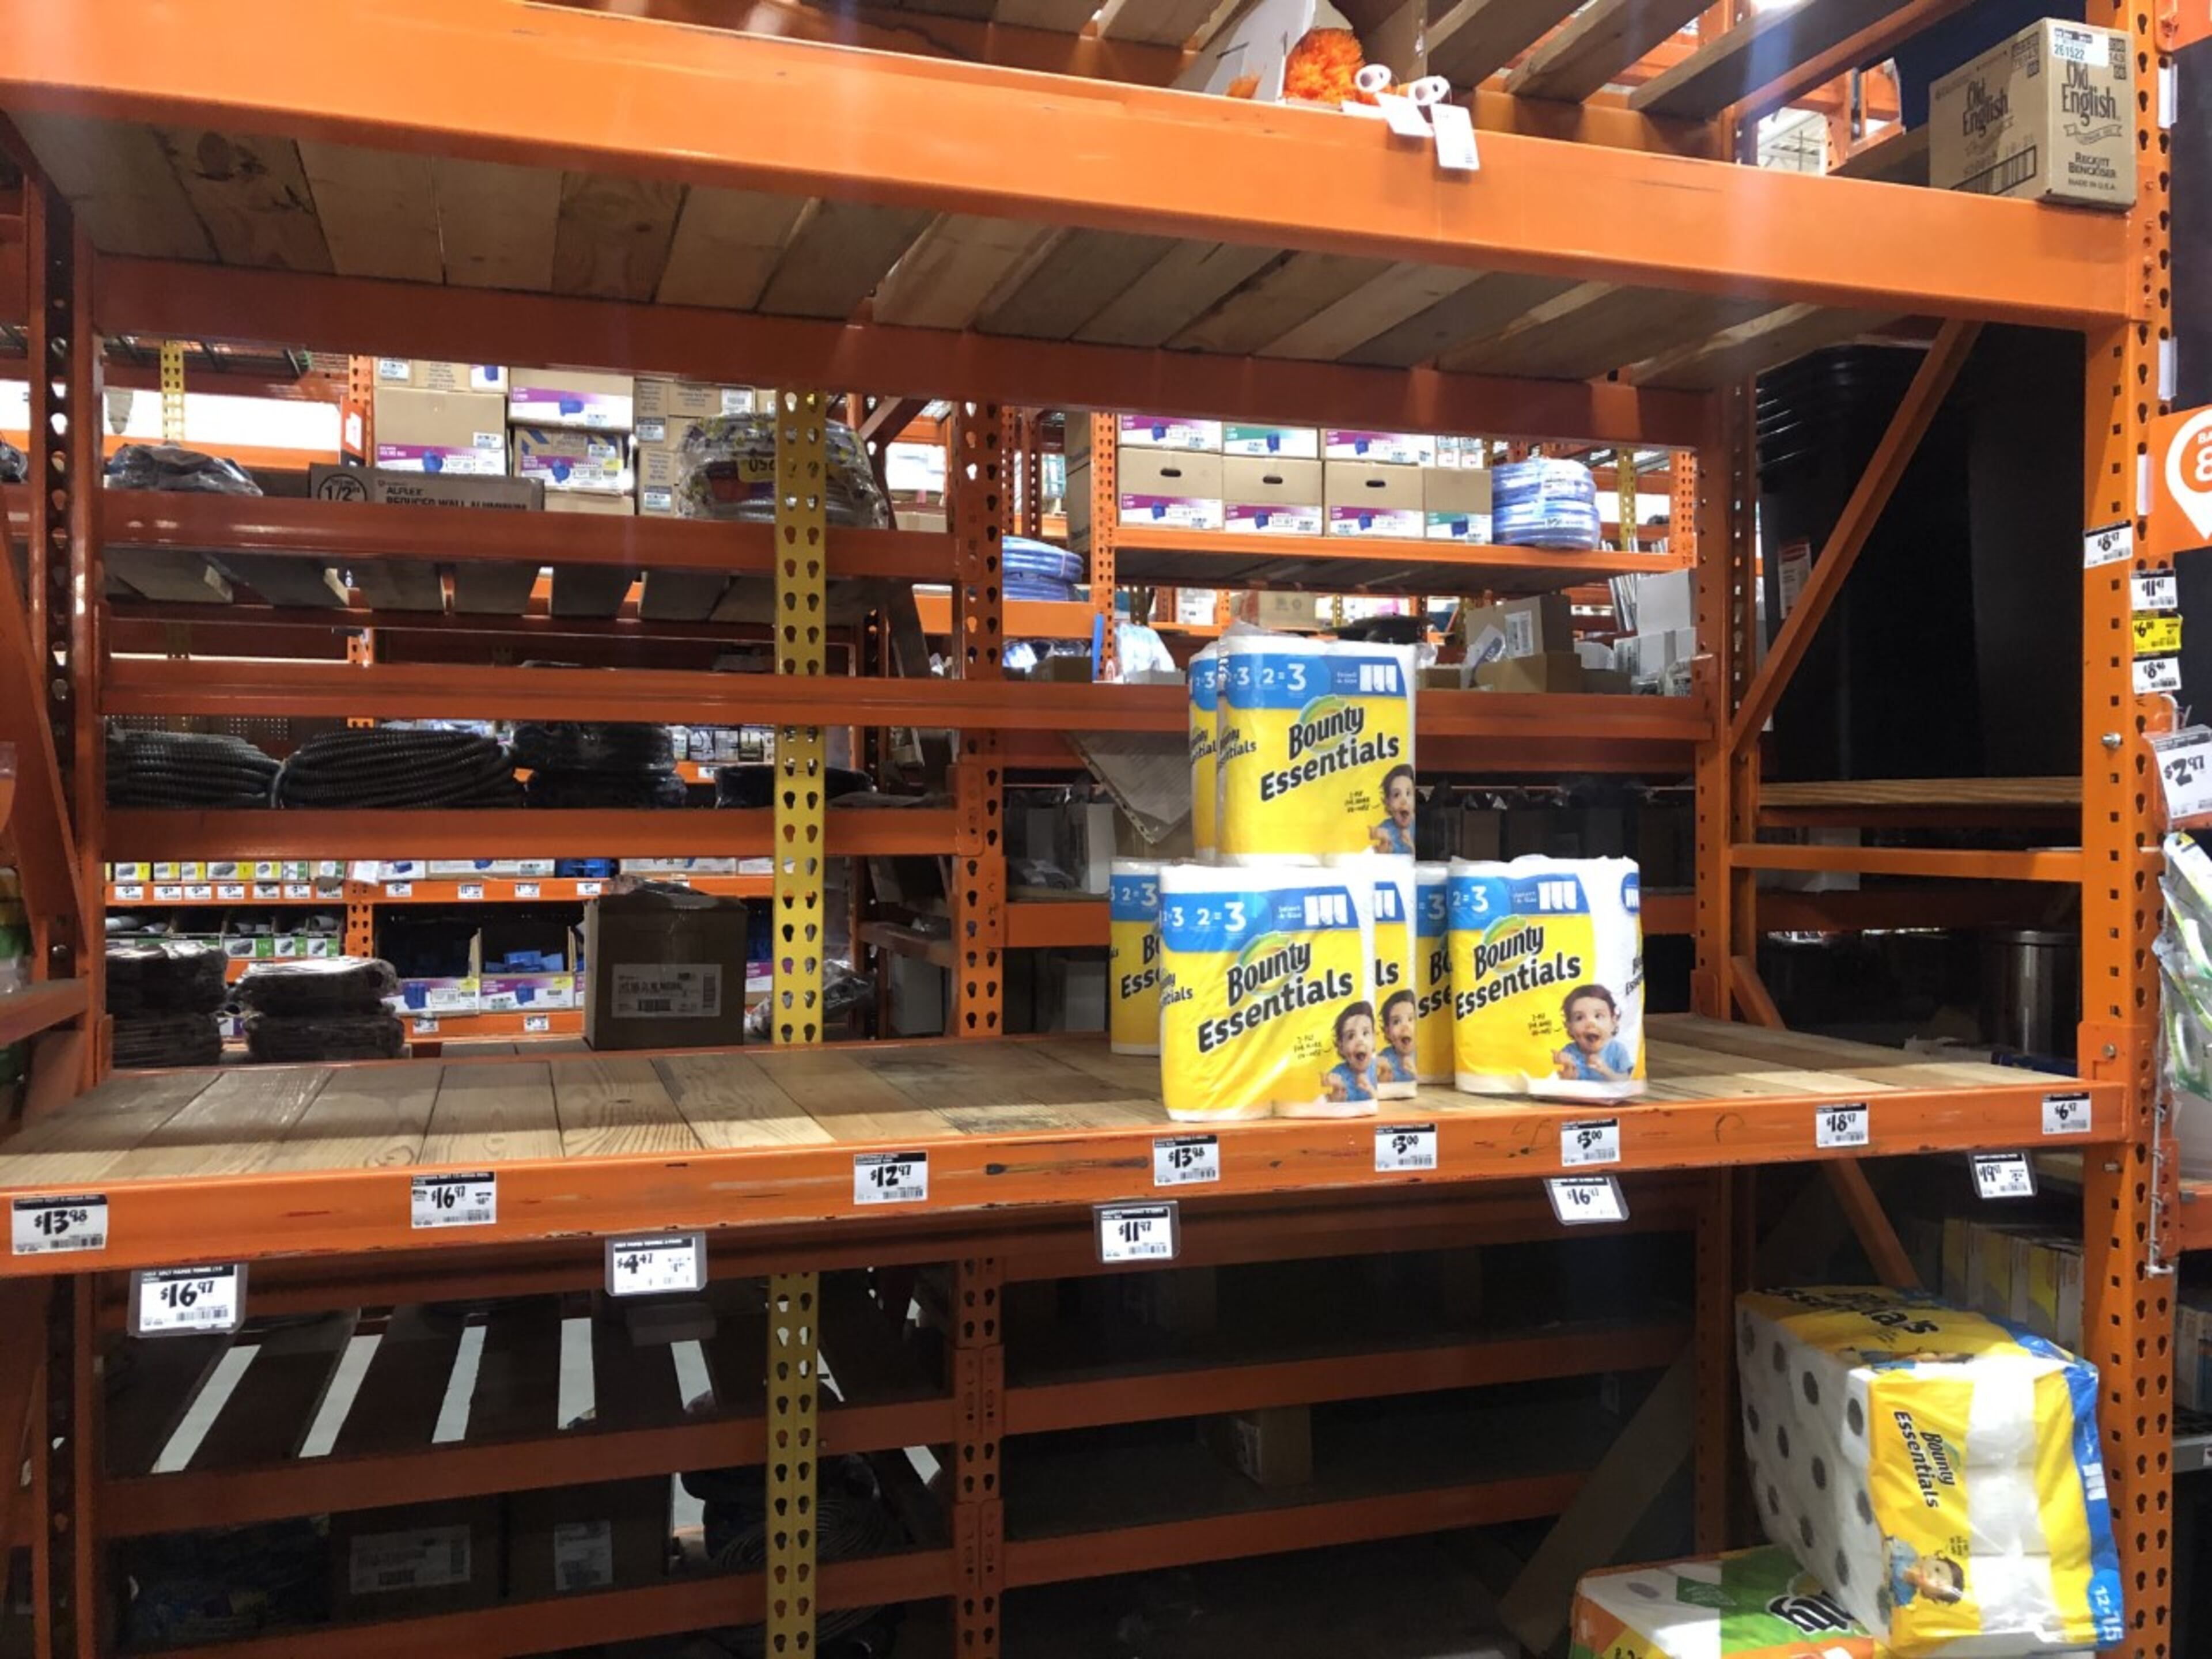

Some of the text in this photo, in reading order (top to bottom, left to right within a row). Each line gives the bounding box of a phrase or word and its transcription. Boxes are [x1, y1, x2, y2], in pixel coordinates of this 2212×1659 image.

[2067, 59, 2088, 89] Old
[1963, 89, 2009, 137] English
[2062, 83, 2116, 127] English
[1289, 705, 1365, 760] Bounty
[1260, 732, 1400, 801] Essentials
[1227, 941, 1312, 1007] Bounty
[1474, 926, 1544, 980] Bounty
[1198, 969, 1354, 1054] Essentials
[1455, 952, 1582, 1021] Essentials
[1894, 1411, 1939, 1508] Essentials
[1920, 1431, 1956, 1486] Bounty
